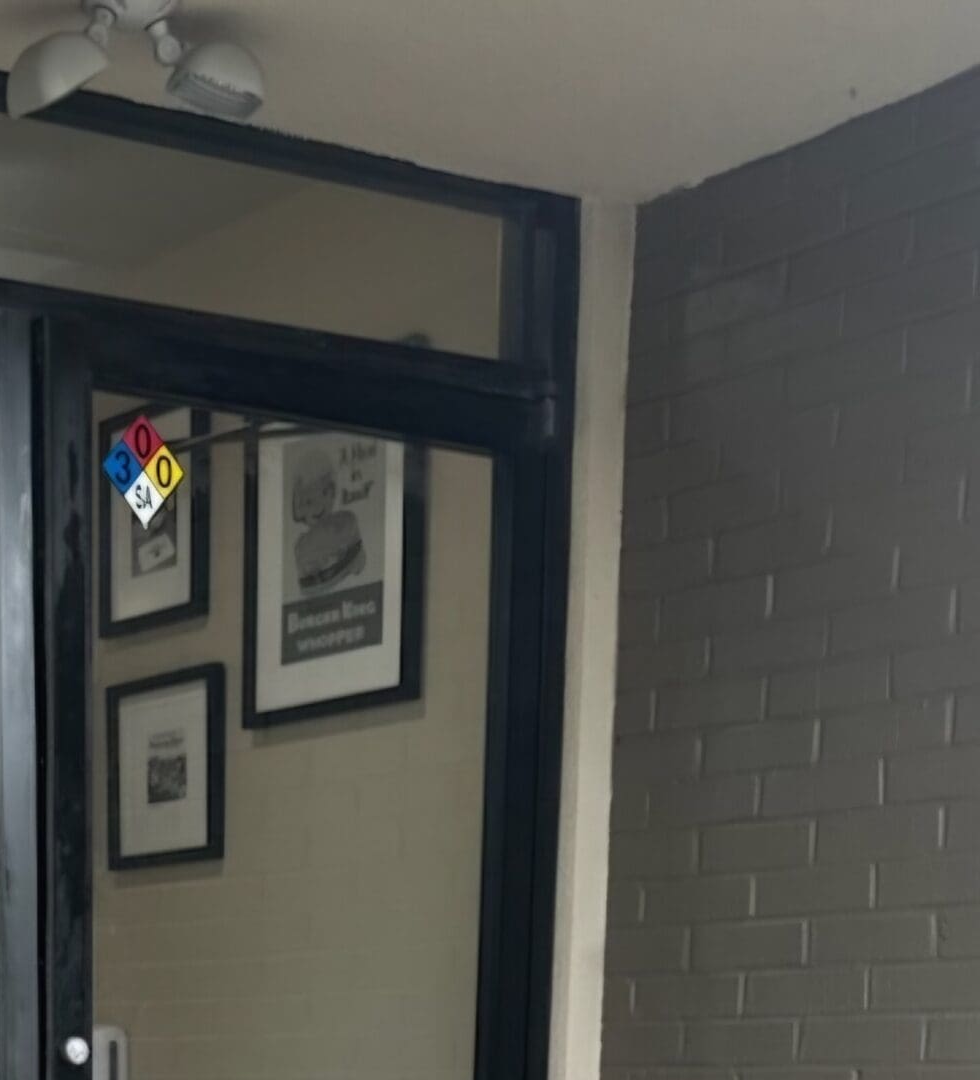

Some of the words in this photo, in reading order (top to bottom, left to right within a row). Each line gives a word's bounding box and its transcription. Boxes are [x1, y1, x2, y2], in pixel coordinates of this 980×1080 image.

[134, 424, 151, 459] 0
[115, 450, 131, 485] 3
[156, 455, 172, 488] 0
